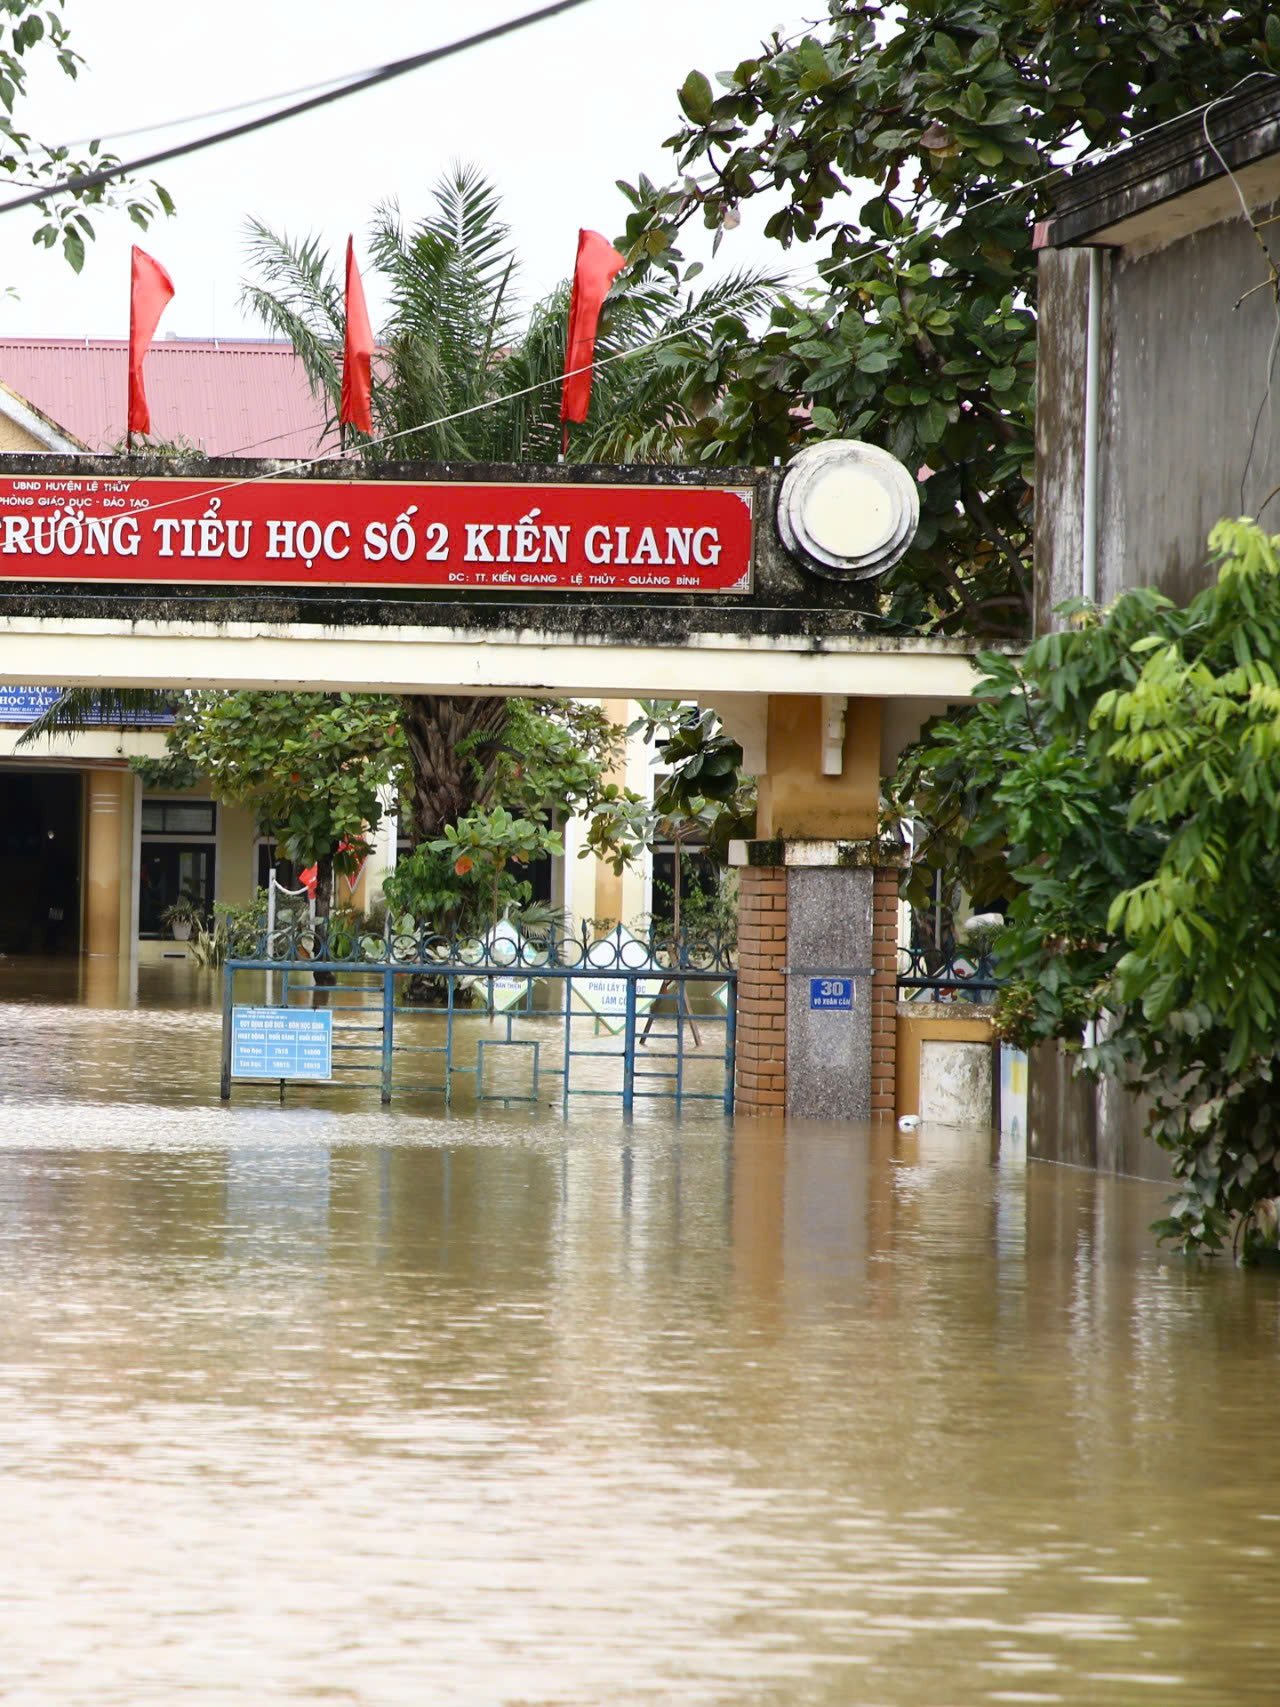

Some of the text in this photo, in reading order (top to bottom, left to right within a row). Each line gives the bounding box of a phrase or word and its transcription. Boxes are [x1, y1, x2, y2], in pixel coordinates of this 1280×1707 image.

[13, 480, 131, 492] UBND HUYỆN LỆ THỦY
[38, 496, 65, 506] GIÁO
[69, 498, 93, 509] DỤC
[129, 498, 150, 509] TẠO
[153, 497, 251, 560] TIỂU
[265, 520, 351, 568] HỌC
[364, 505, 418, 562] SỐ
[426, 523, 450, 562] 2
[464, 507, 570, 564] KIẾN
[584, 526, 722, 566] GIANG
[448, 573, 470, 582] ĐC:
[475, 573, 488, 582] TT.
[492, 570, 516, 583] KIẾN
[520, 574, 557, 583] GIANG
[570, 573, 583, 585] LỆ
[589, 572, 616, 584] THỦY
[628, 574, 670, 585] QUẢNG
[28, 693, 53, 708] TẬP
[820, 981, 844, 996] 30
[822, 997, 838, 1005] XUÂN
